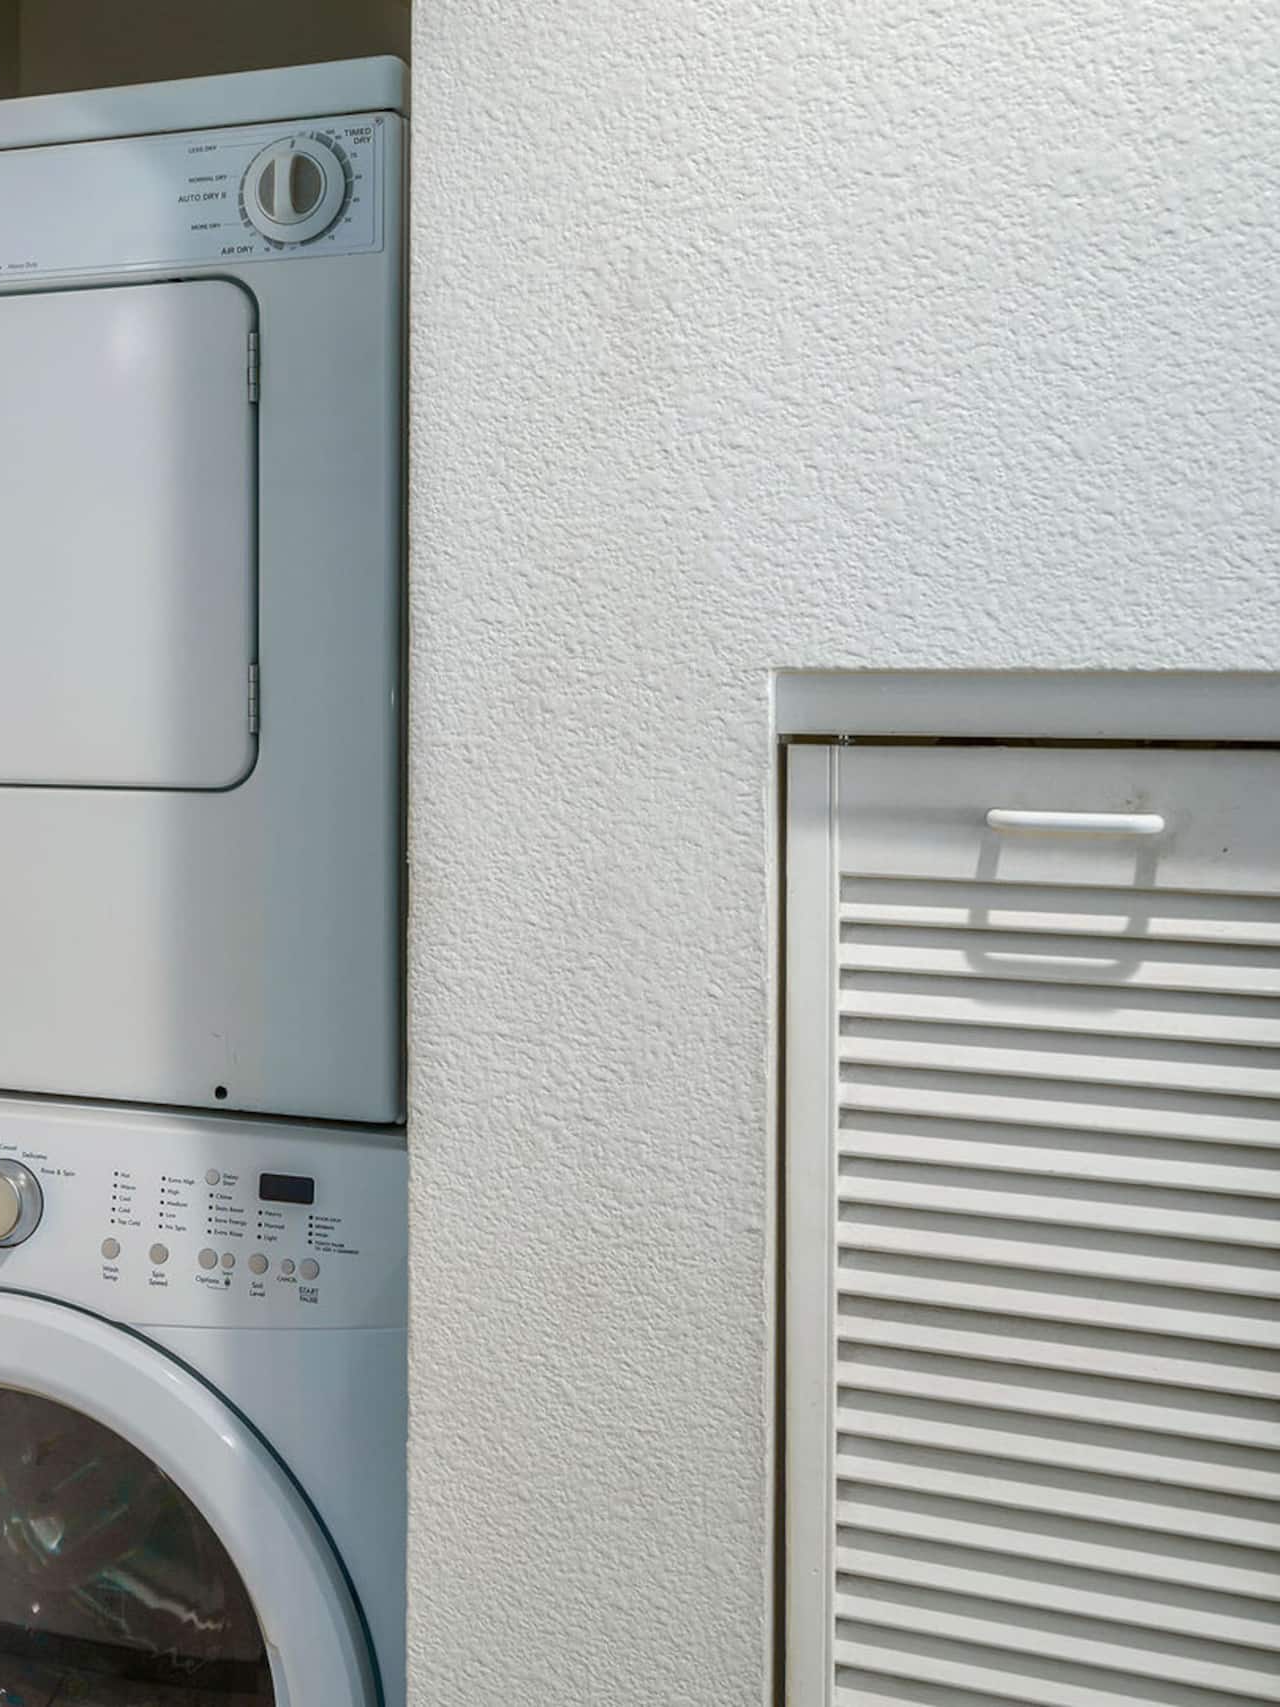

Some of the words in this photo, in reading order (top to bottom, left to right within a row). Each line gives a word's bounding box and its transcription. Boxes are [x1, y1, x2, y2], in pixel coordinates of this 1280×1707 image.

[345, 128, 372, 137] TIMED
[354, 136, 372, 144] DRY
[178, 194, 201, 203] AUTO
[203, 193, 220, 201] DRY
[222, 247, 235, 256] AIR
[237, 246, 253, 254] DRY
[299, 1287, 319, 1295] START
